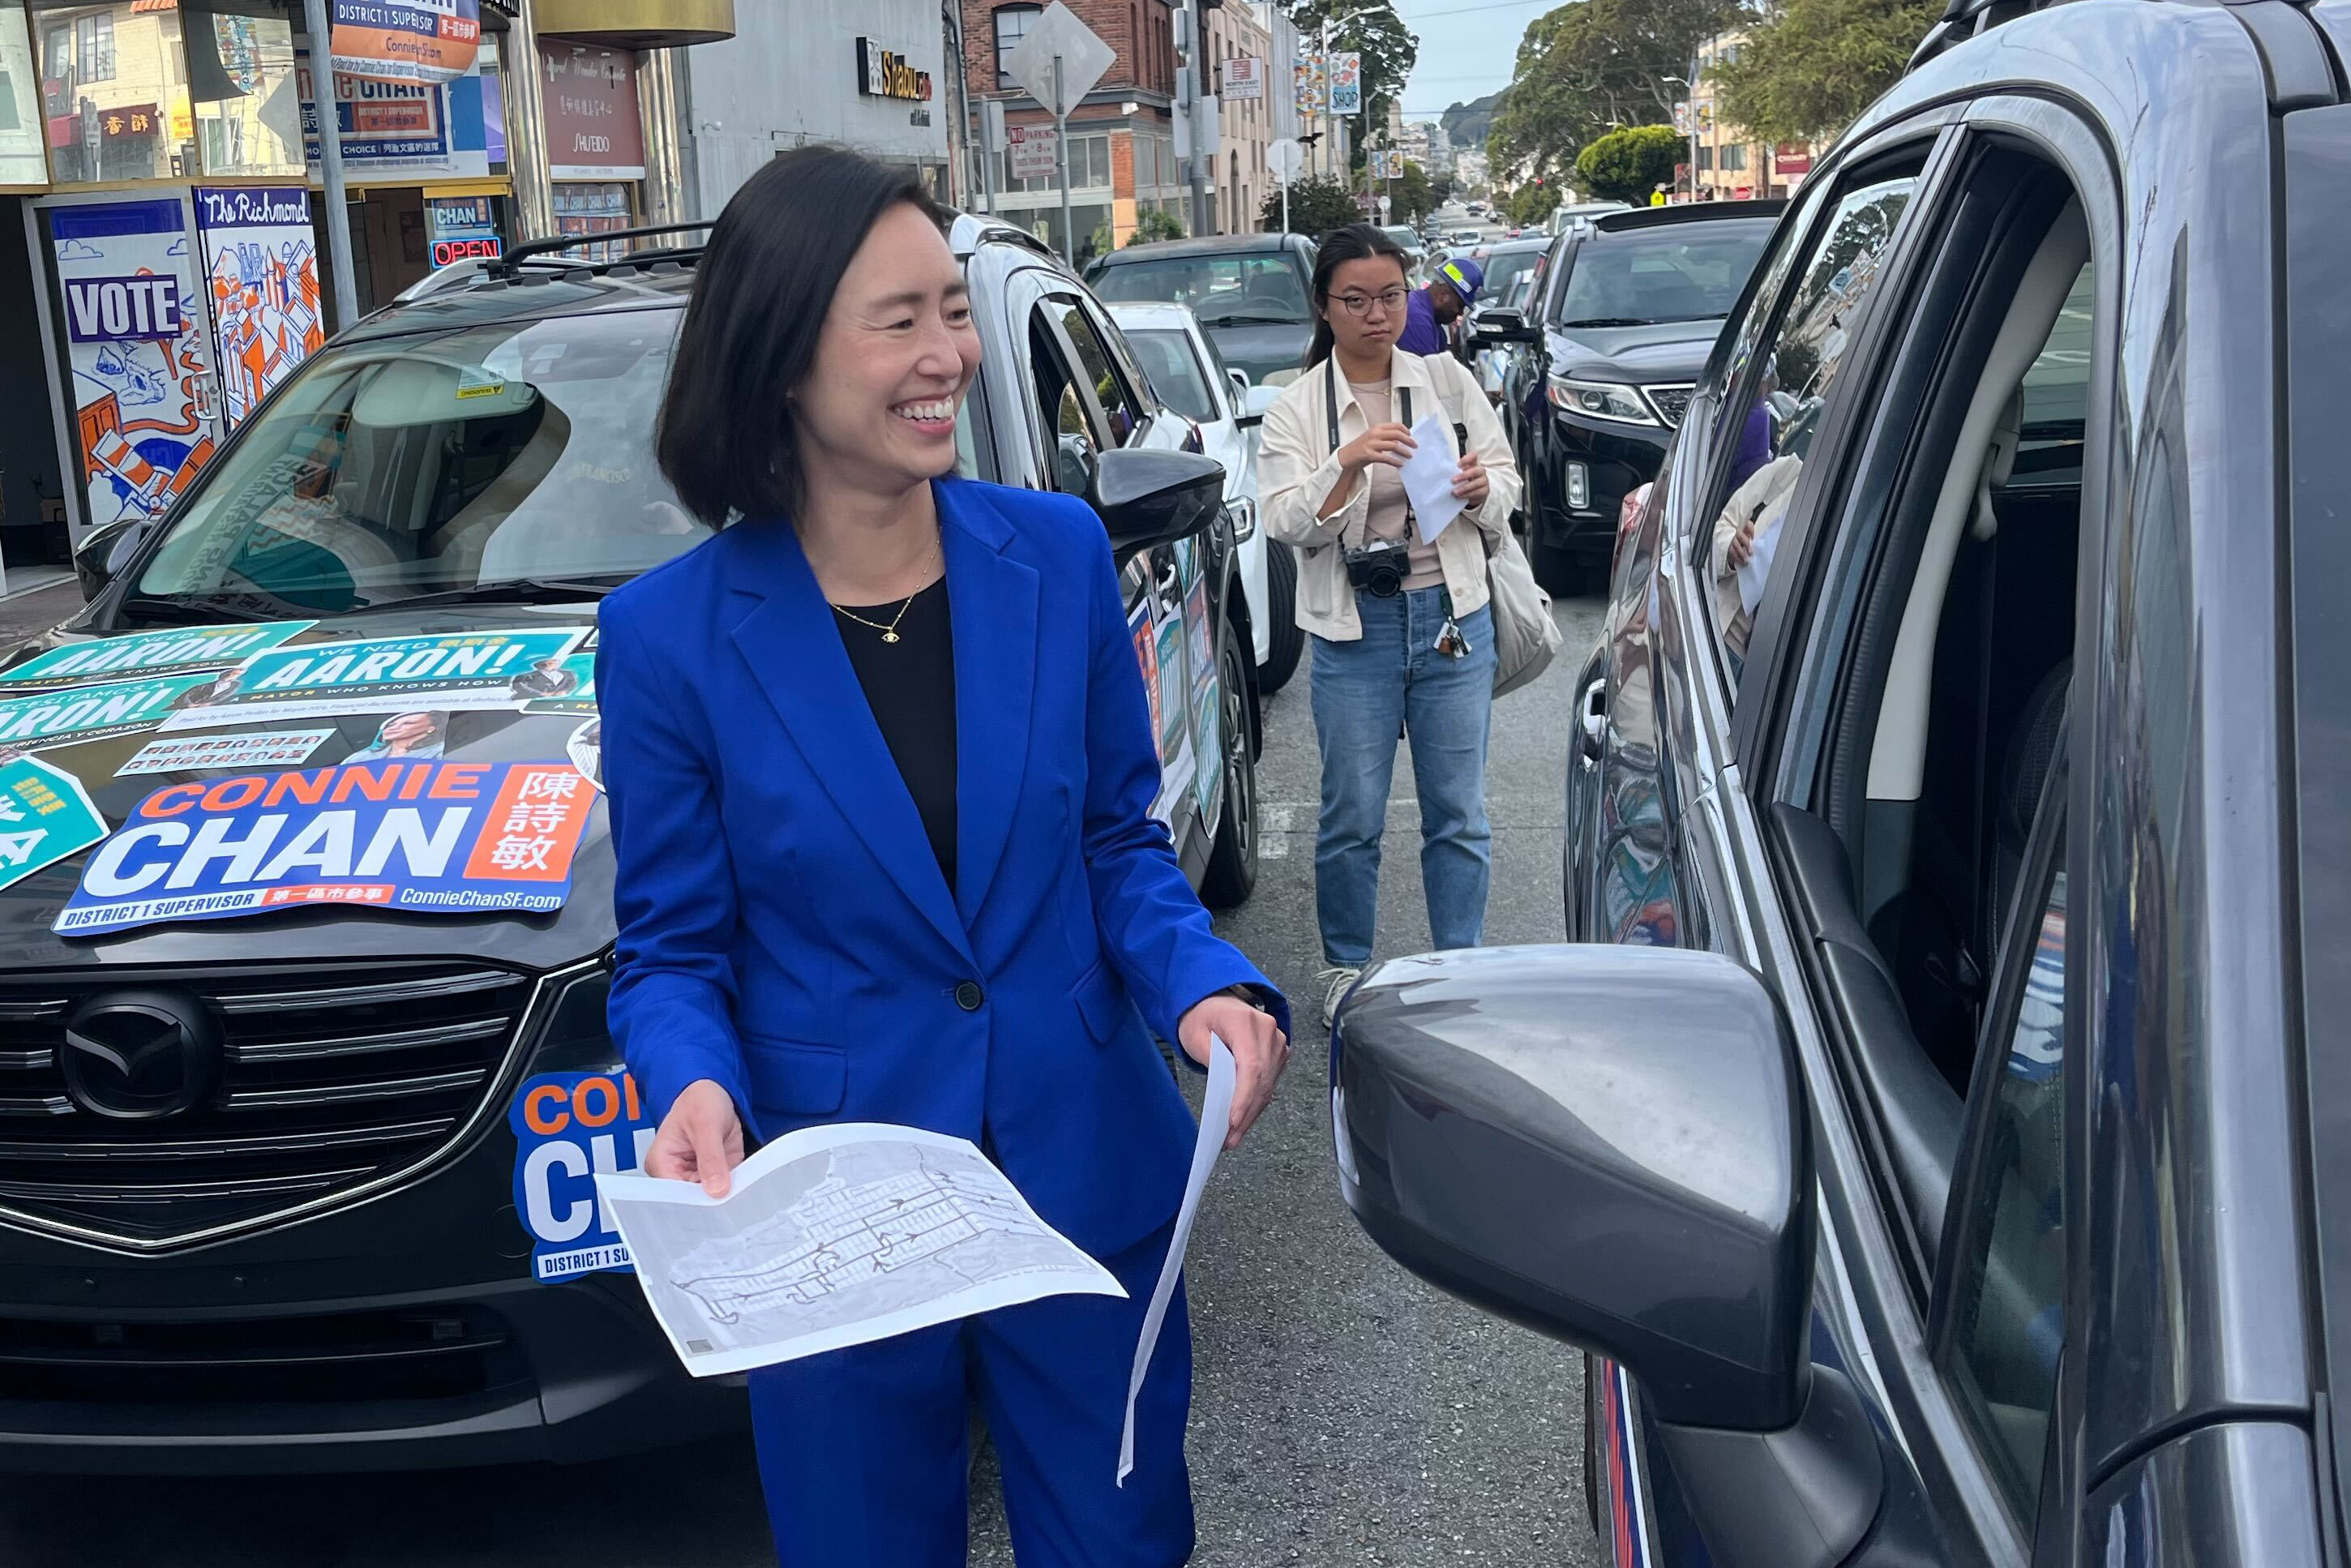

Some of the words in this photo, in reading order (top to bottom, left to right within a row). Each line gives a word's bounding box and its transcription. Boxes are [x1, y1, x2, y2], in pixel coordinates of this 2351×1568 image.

[339, 4, 382, 24] DISTRICT
[384, 11, 388, 24] 1
[1011, 128, 1025, 143] NO
[204, 194, 235, 223] The
[235, 191, 309, 223] Richmond
[437, 208, 476, 225] CHAN
[435, 241, 498, 264] OPEN
[69, 281, 179, 336] VOTE
[103, 639, 128, 648] WE
[143, 632, 195, 644] NEED
[319, 647, 357, 657] WE
[362, 641, 430, 652] NEED
[32, 632, 272, 677] AARON!
[252, 645, 526, 690] AARON!
[20, 678, 75, 688] MAYOR
[83, 671, 118, 681] WHO
[124, 664, 187, 675] KNOWS
[191, 661, 226, 670] HOW
[0, 685, 148, 712] ECESITAMOS
[250, 691, 316, 700] MAYOR
[328, 686, 369, 694] WHO
[378, 682, 448, 691] KNOWS
[458, 679, 503, 687] HOW
[0, 688, 175, 738] ARON!
[0, 733, 73, 749] PERIENCIA
[139, 764, 492, 817] CONNIE
[490, 771, 580, 872] 陳詩敏
[82, 807, 472, 898] CHAN
[272, 886, 383, 903] 第一區市參事
[400, 888, 562, 909] ConnieChanSF.com
[64, 905, 140, 927] DISTRICT
[142, 904, 150, 917] 1
[153, 893, 255, 915] SUPERVISOR
[525, 1128, 655, 1242] CH
[545, 1252, 600, 1273] DISTRICT
[605, 1251, 610, 1263] 1
[614, 1248, 630, 1263] SU
